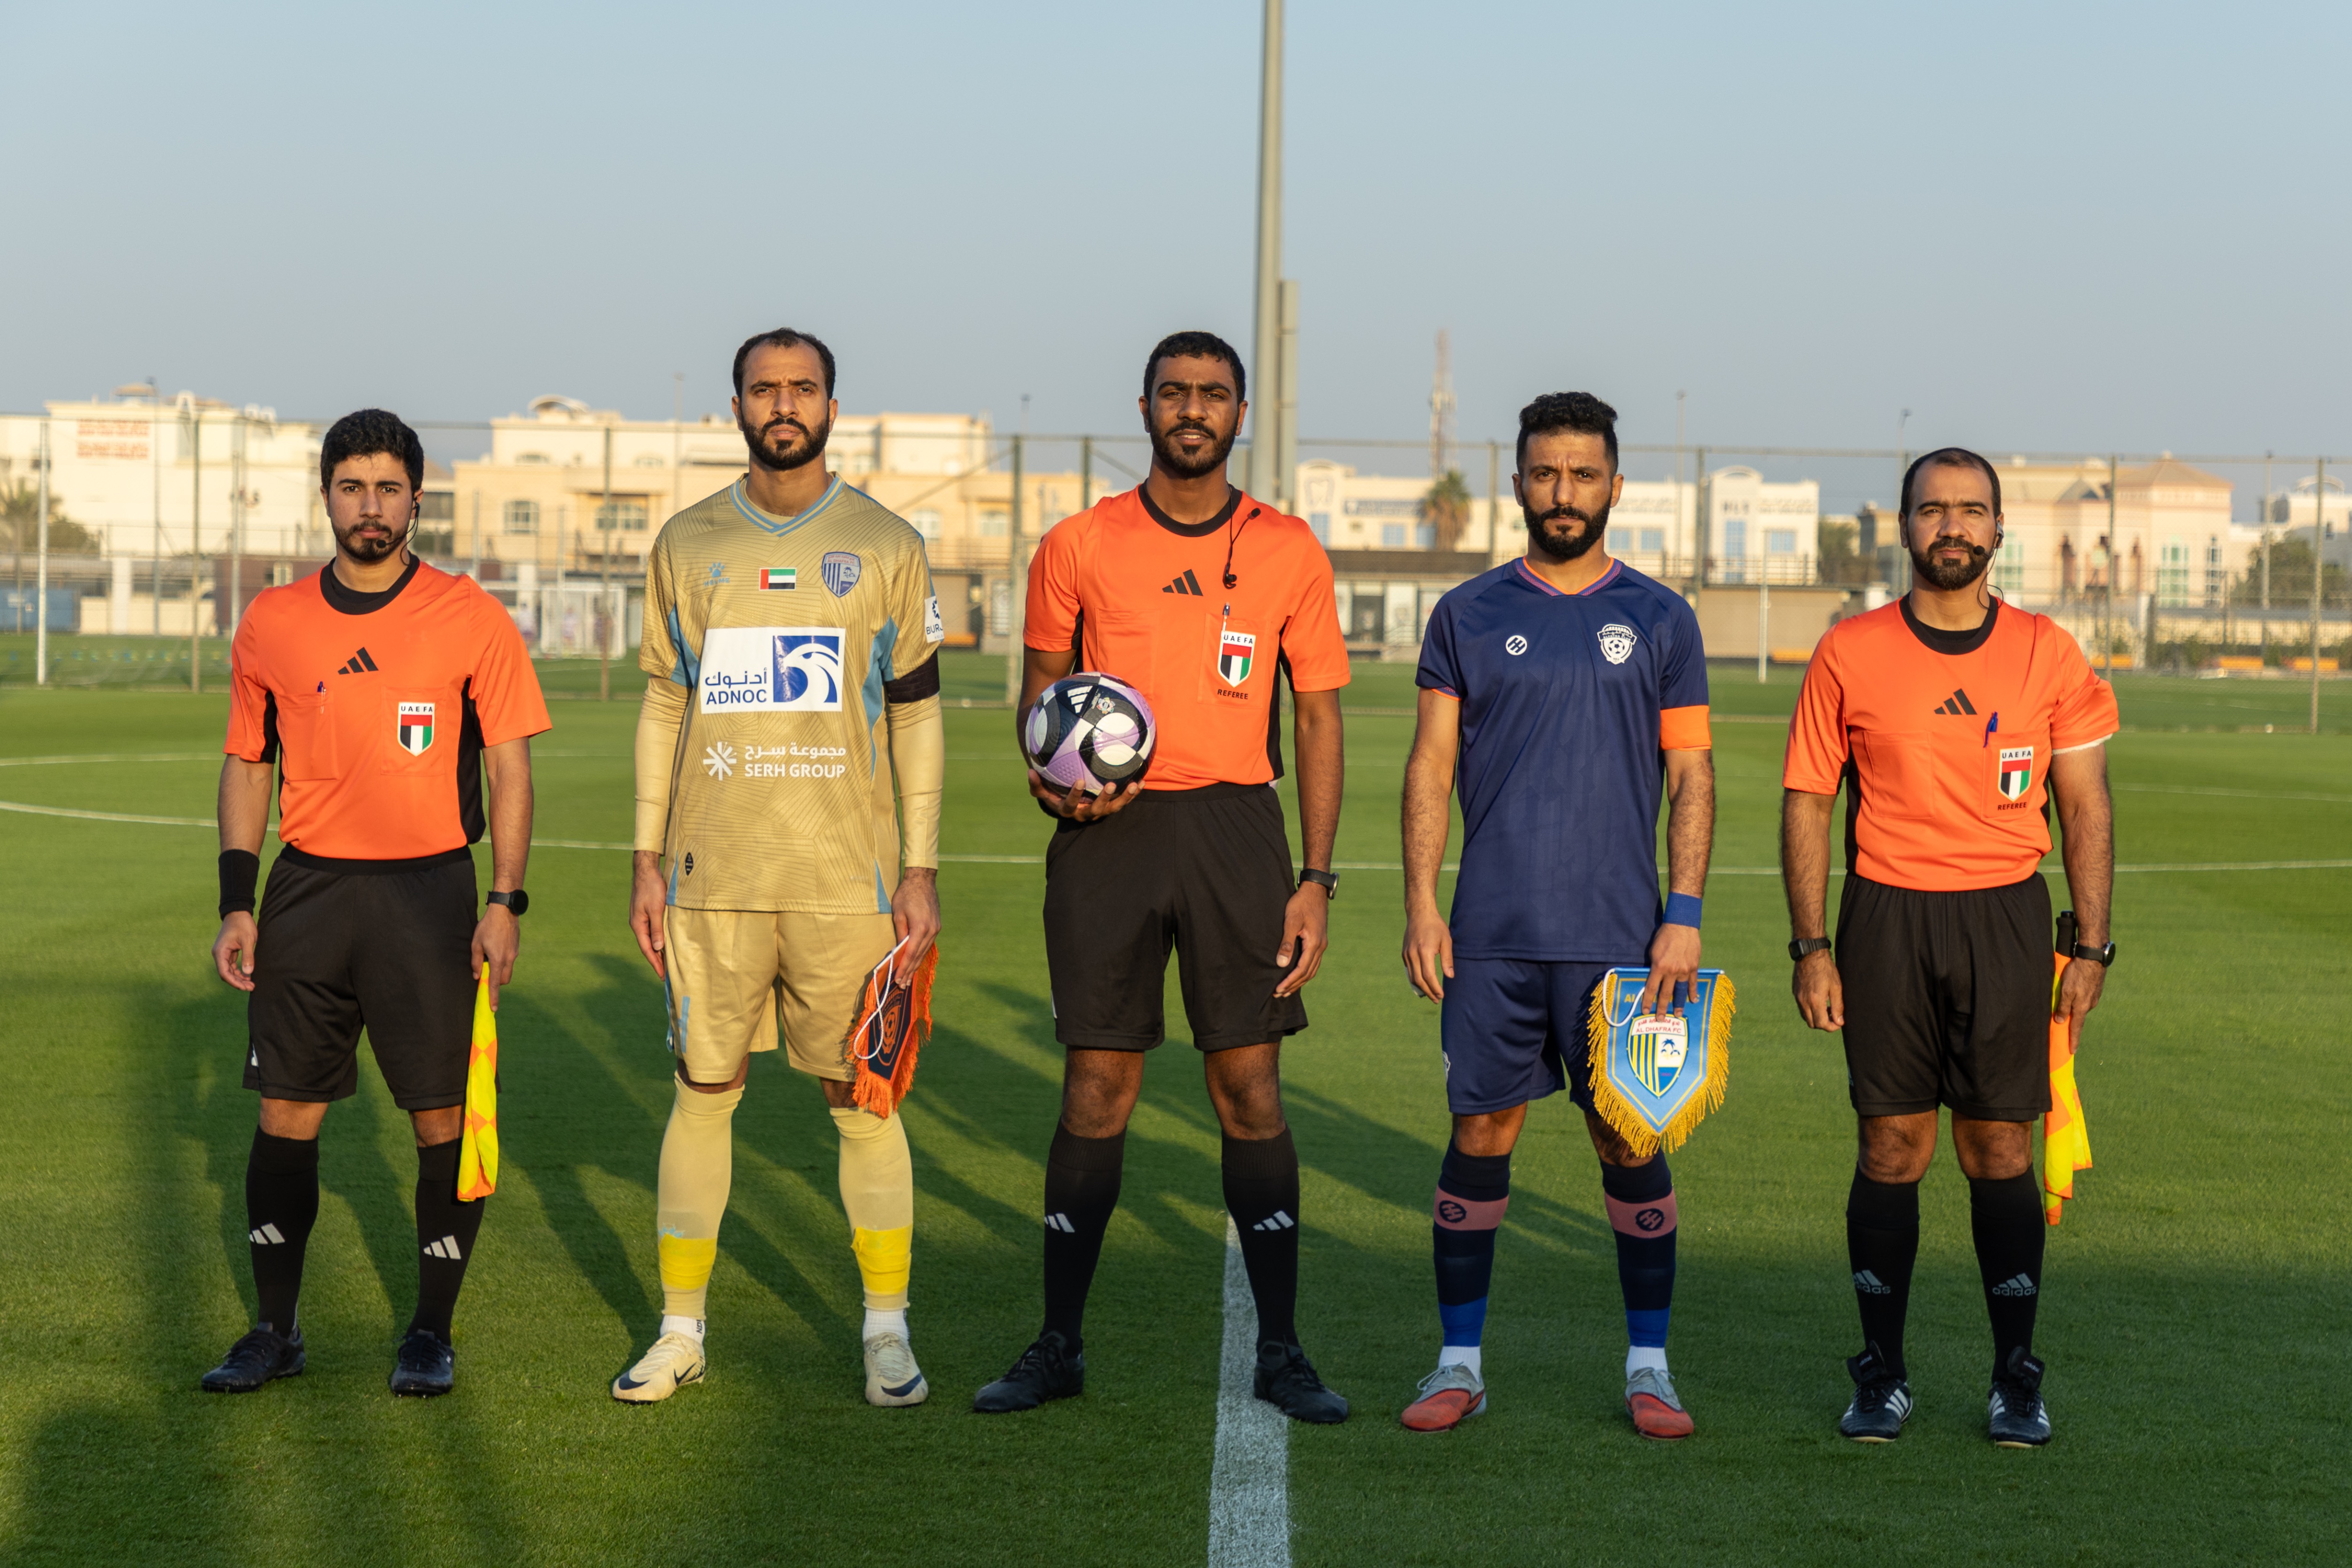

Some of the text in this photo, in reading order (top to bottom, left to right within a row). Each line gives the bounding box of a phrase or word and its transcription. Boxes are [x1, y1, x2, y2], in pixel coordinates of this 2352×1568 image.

[704, 577, 731, 586] KELME
[705, 667, 767, 689] أدنوك
[706, 689, 767, 705] ADNOC
[1217, 689, 1248, 700] REFEREE
[790, 742, 846, 760] مجموعة
[745, 763, 846, 778] SERH GROUP
[1998, 802, 2027, 810] REFEREE
[1992, 1286, 2036, 1297] adidas
